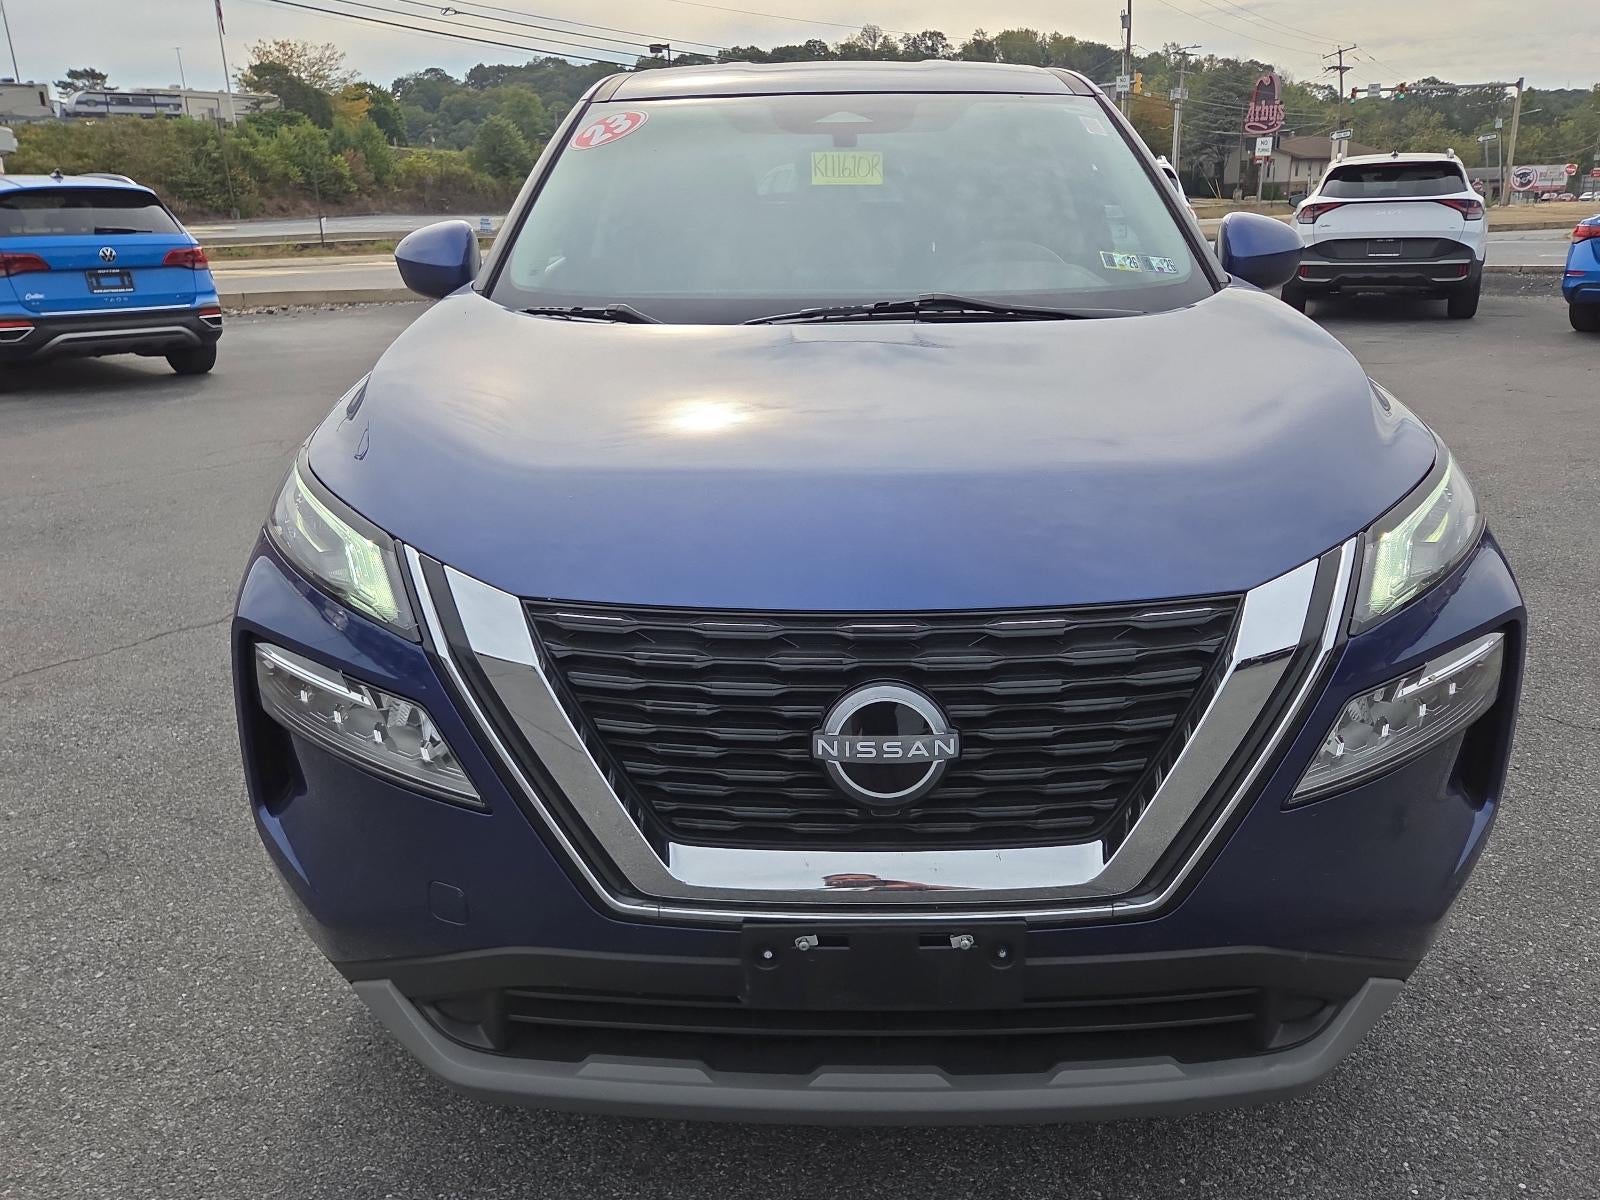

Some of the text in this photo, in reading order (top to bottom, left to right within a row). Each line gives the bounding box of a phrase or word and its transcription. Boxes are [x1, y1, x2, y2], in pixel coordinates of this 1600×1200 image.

[1244, 100, 1285, 126] Arby's
[582, 113, 633, 146] 23
[817, 738, 955, 758] NISSAN
